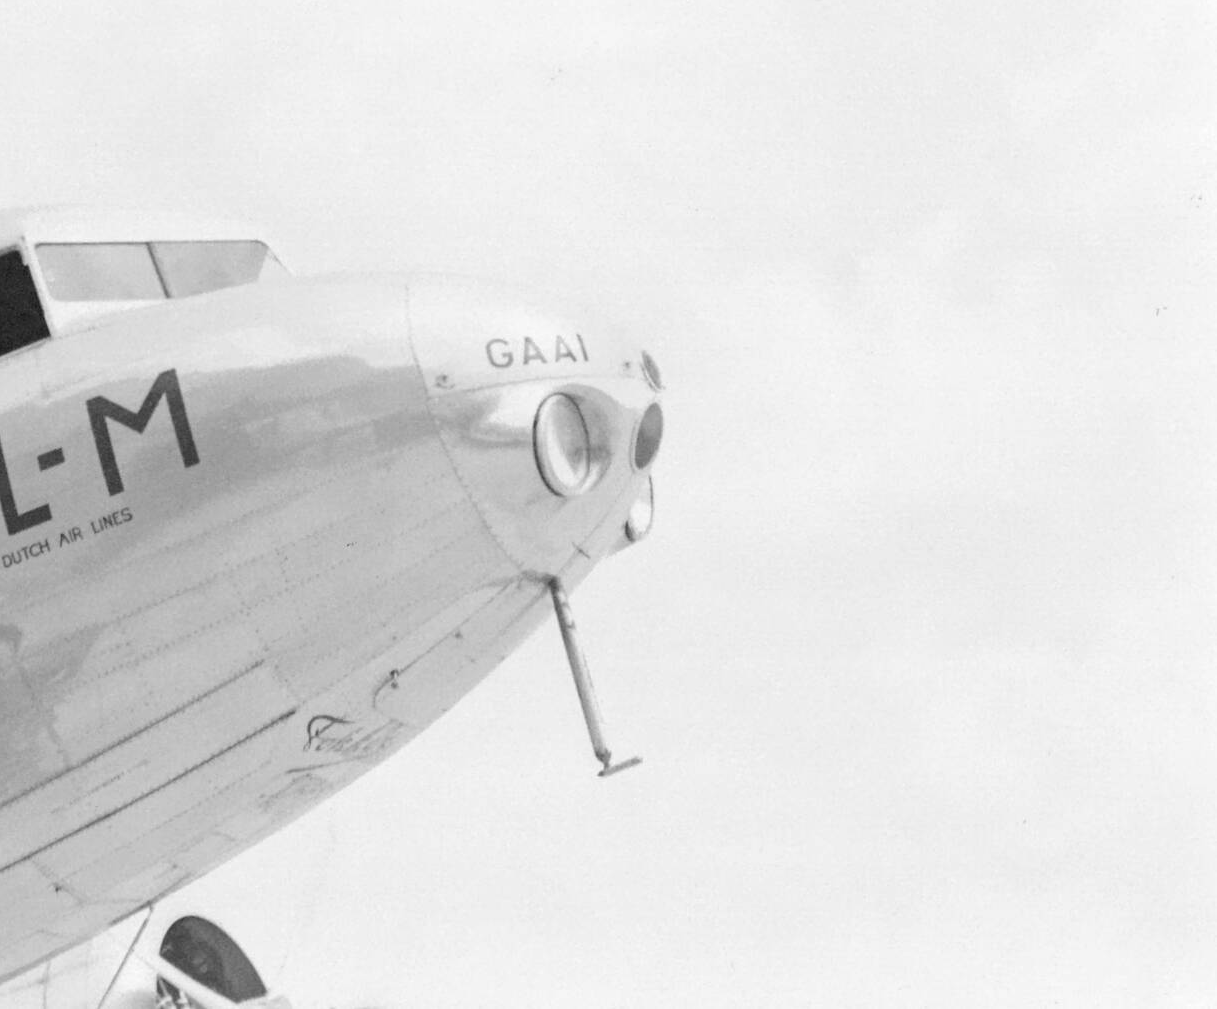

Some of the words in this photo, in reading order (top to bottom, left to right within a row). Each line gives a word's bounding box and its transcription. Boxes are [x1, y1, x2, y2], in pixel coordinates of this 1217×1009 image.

[485, 333, 589, 369] GAAI
[1, 539, 52, 569] DUTCH
[59, 526, 84, 548] AIR
[90, 507, 134, 535] LINES
